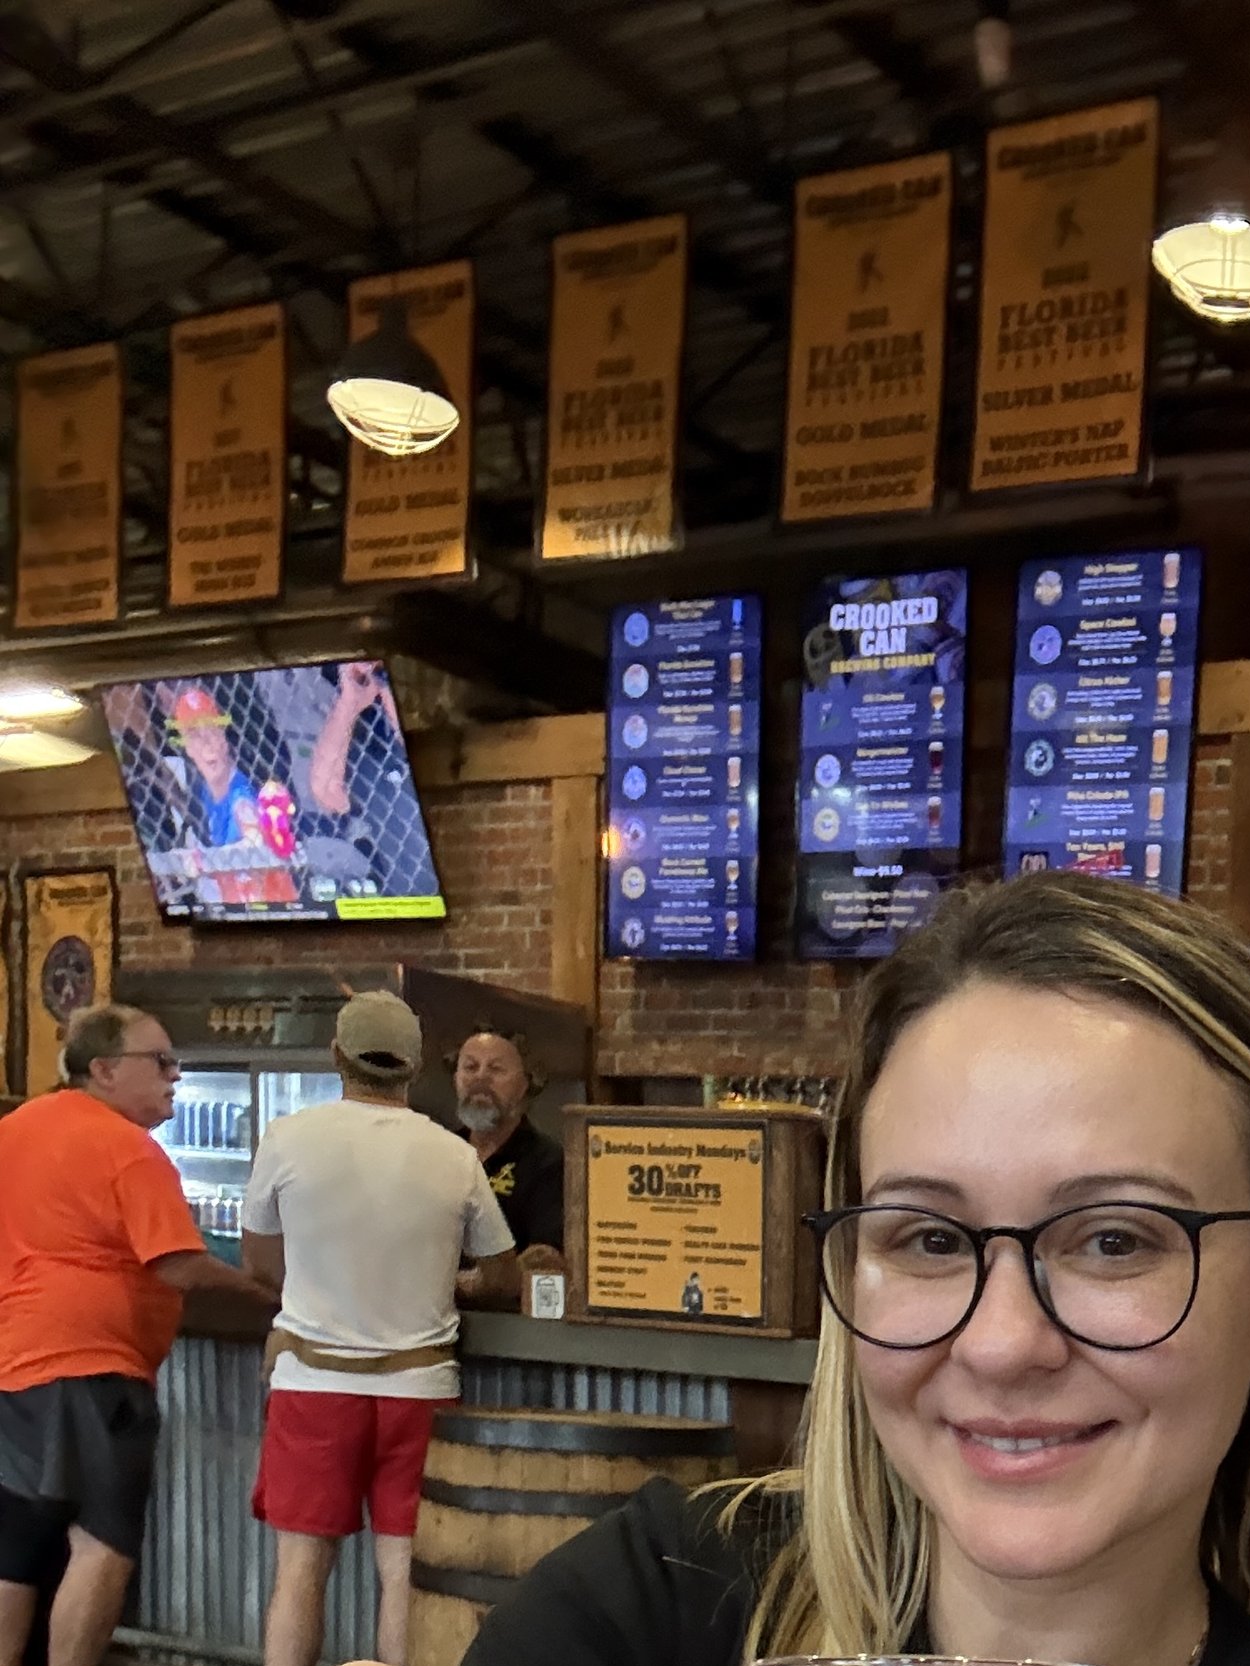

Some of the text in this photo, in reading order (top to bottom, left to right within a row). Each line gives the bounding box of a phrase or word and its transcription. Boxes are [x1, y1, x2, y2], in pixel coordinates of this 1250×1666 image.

[1000, 288, 1127, 330] FLORIDA
[997, 316, 1127, 353] BEST BEER
[809, 331, 923, 370] FLORIDA
[982, 371, 1137, 411] SILVER MEDAL
[796, 414, 926, 445] GOLD MEDAL
[1087, 419, 1125, 442] NAP
[829, 597, 938, 631] CROOKED
[860, 628, 907, 656] CAN
[830, 654, 936, 674] BREWING COMPANY
[605, 1141, 746, 1161] Service Industry Mondays
[628, 1165, 664, 1196] 30
[665, 1184, 721, 1198] DRAFTS
